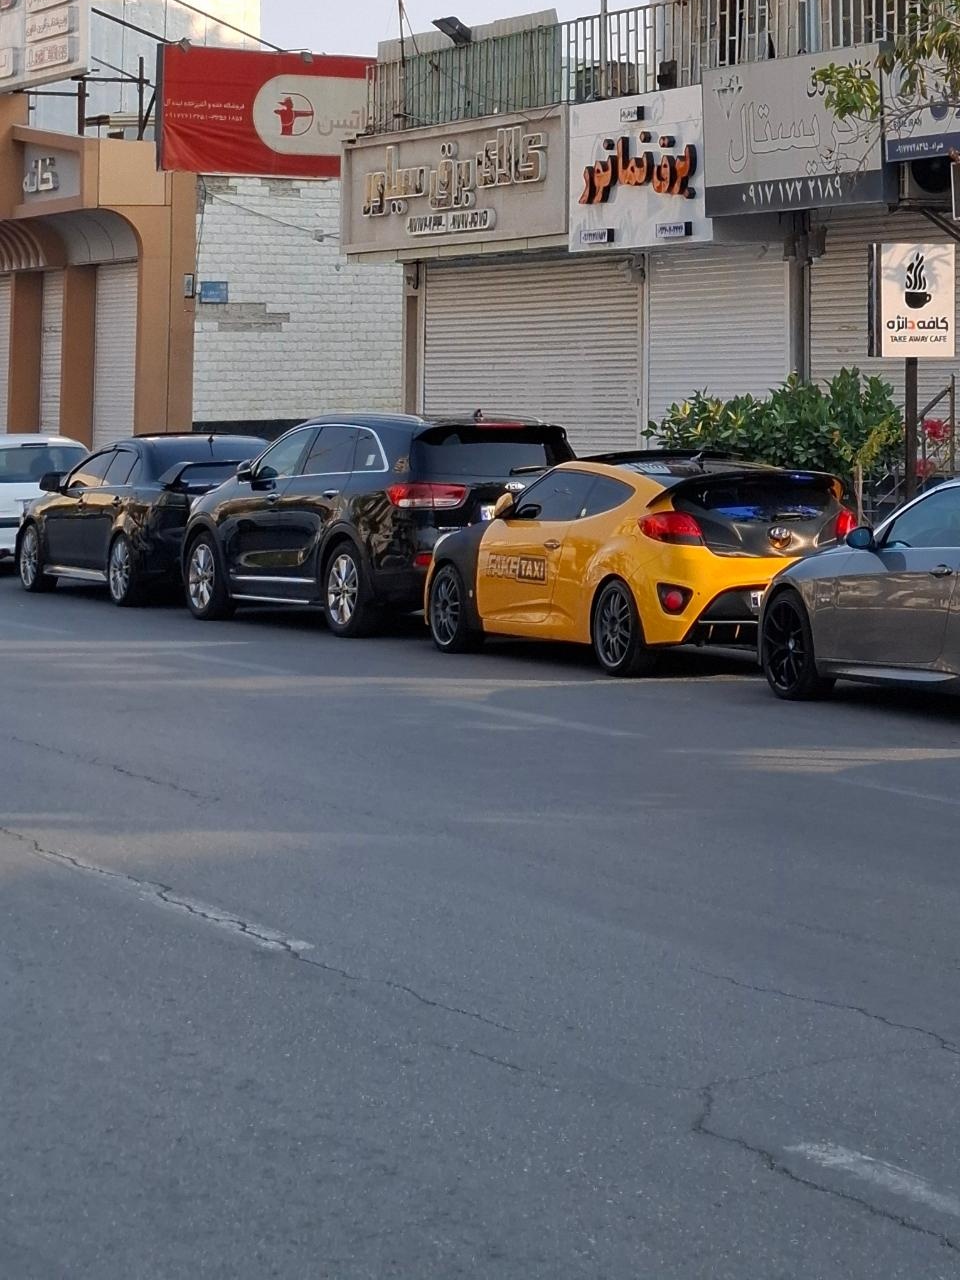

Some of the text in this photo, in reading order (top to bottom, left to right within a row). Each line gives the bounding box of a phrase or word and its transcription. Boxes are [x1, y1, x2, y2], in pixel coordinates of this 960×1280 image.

[476, 125, 546, 189] کالای
[428, 142, 475, 210] برق
[742, 175, 843, 206] ۰۹۱۷ ۱۷۲ ۲۱۸۹
[886, 315, 949, 333] کافه دانژه
[890, 335, 947, 343] TAKE AWAY CAFE
[520, 560, 544, 579] TAXI
